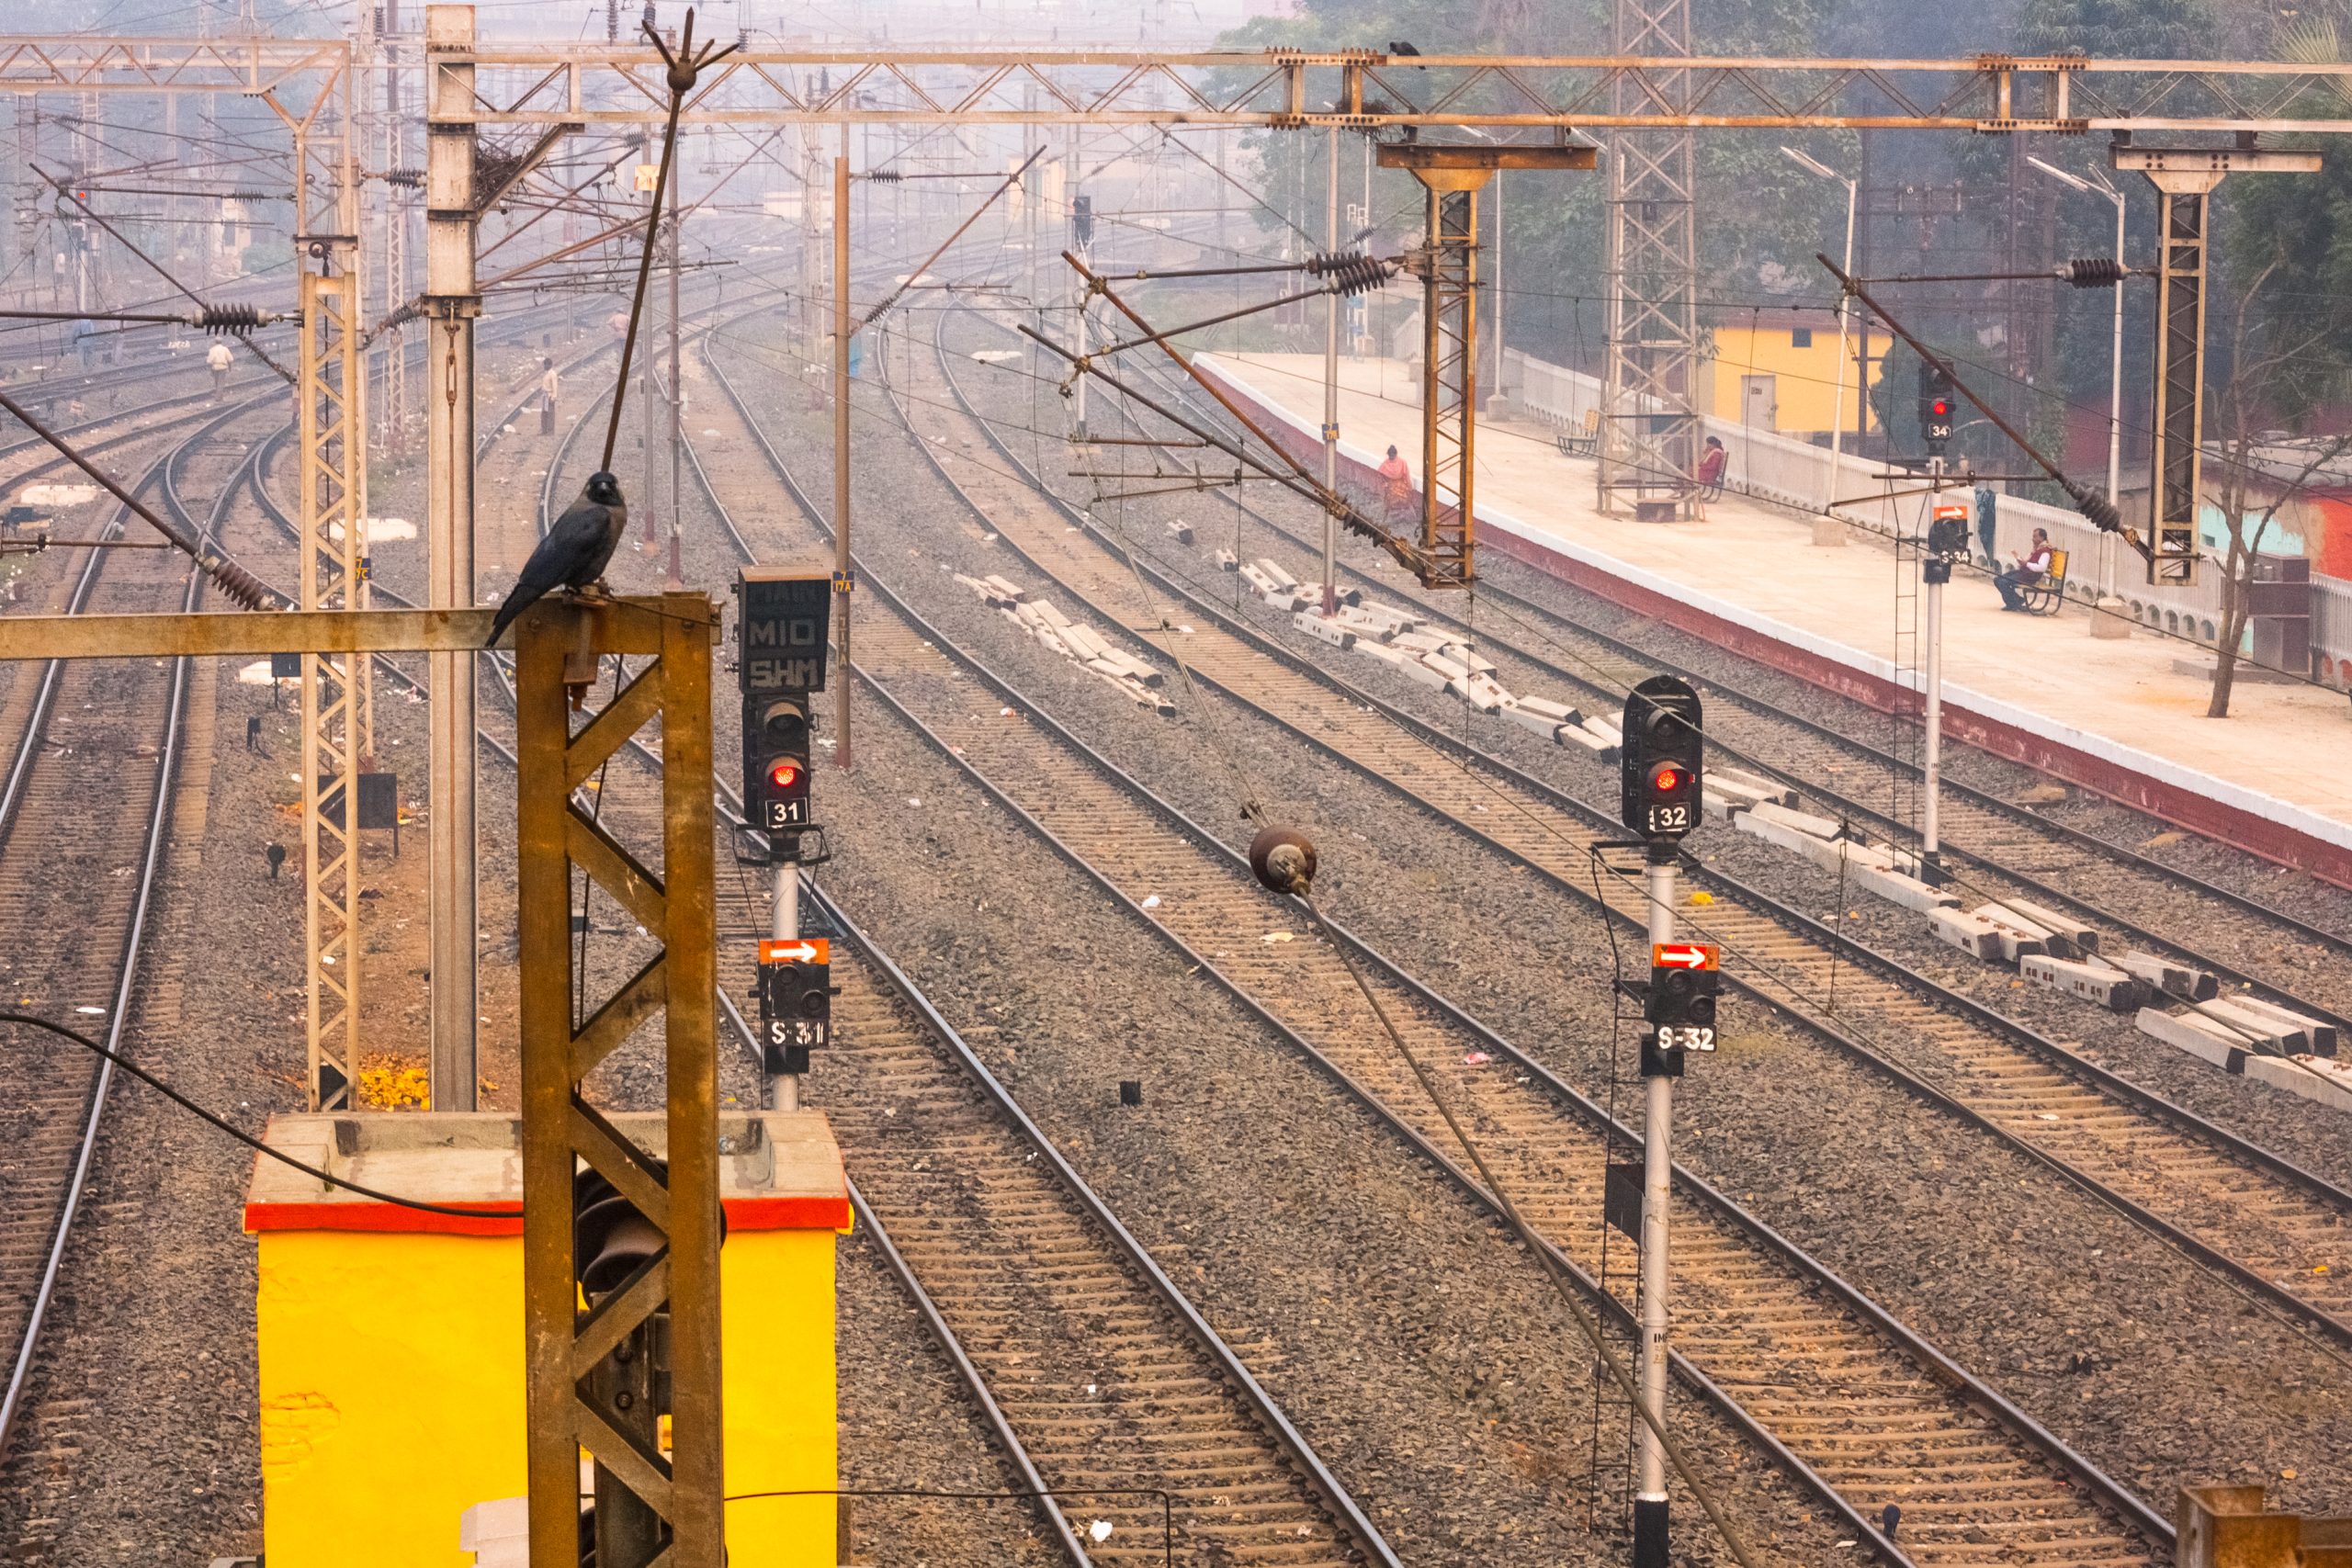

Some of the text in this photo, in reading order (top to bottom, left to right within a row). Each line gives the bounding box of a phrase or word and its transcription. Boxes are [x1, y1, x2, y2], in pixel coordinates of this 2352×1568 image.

[1932, 425, 1948, 436] 34
[841, 571, 847, 581] 7
[835, 581, 851, 592] 17A
[750, 659, 819, 688] SHM
[775, 802, 797, 822] 31
[1660, 807, 1687, 827] 32
[1658, 1026, 1714, 1051] S-32
